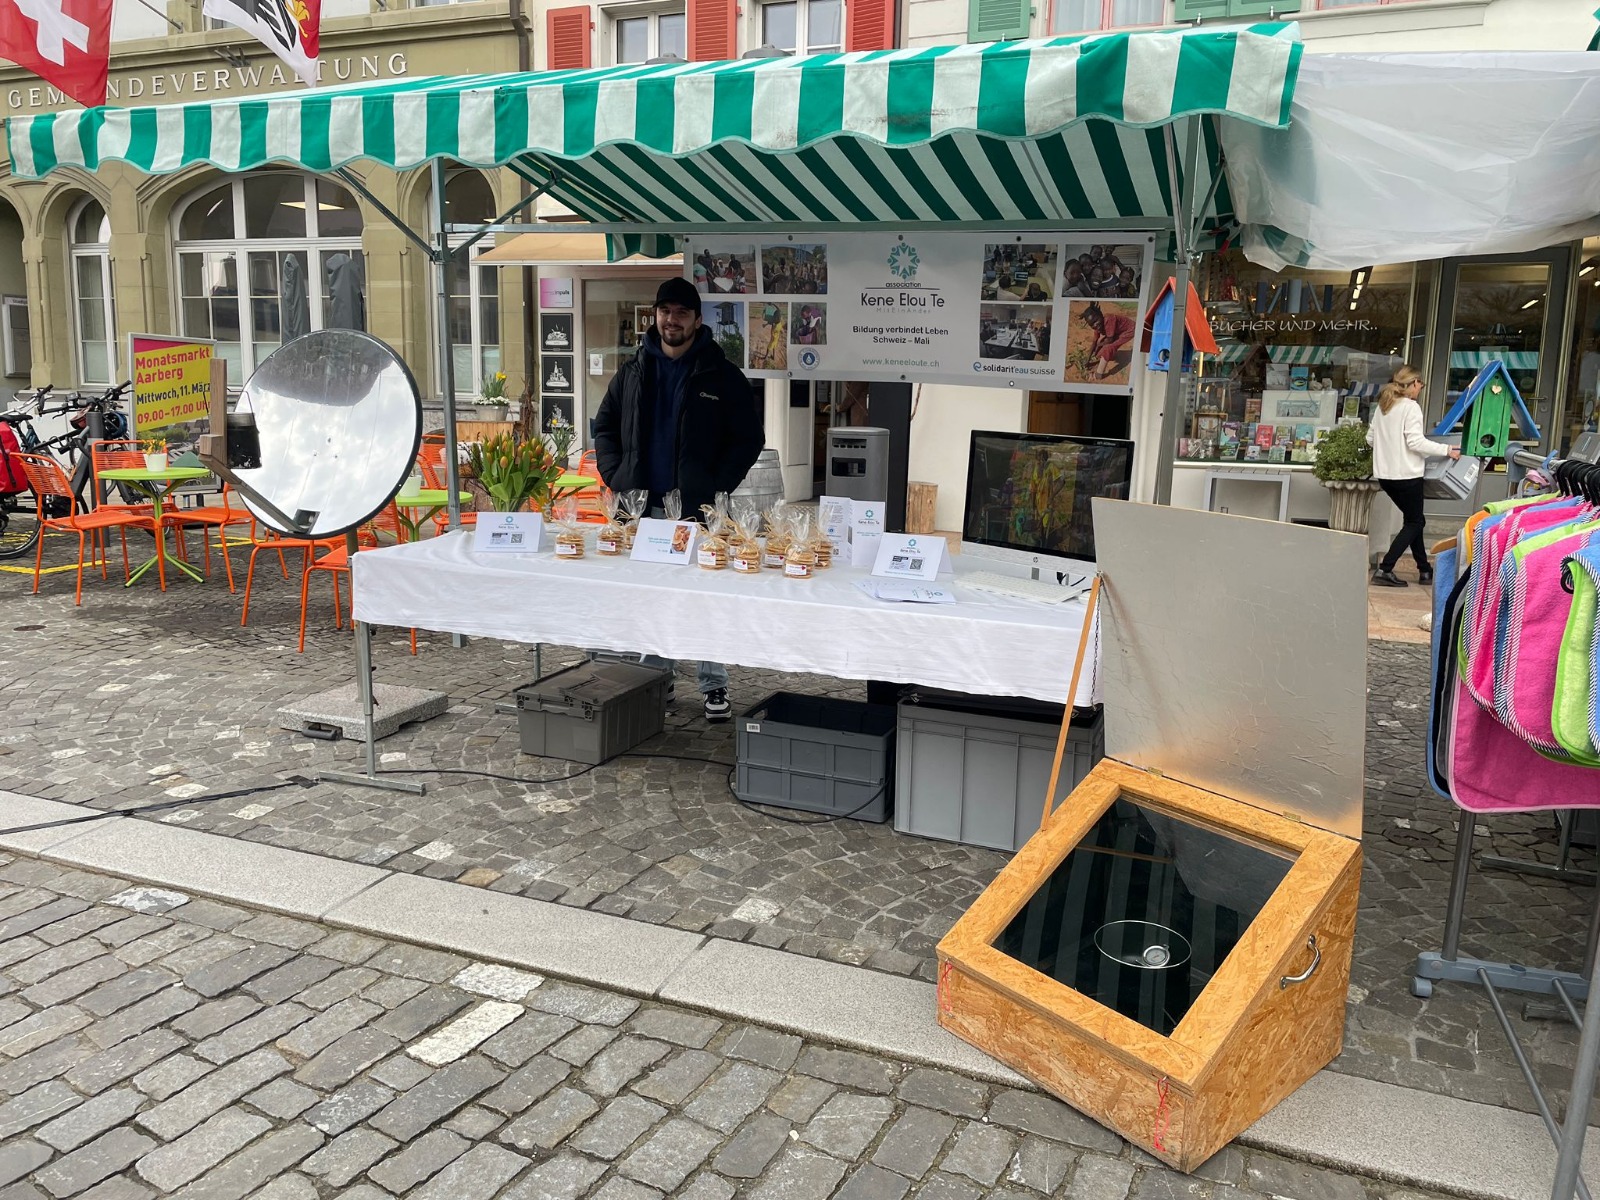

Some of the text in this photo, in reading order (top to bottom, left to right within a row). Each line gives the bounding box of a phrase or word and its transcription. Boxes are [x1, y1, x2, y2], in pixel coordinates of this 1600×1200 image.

[861, 292, 945, 308] Kene Elou Te
[852, 325, 949, 336] Bildung verbindet Leben
[1280, 319, 1316, 332] UND
[872, 335, 907, 345] Schweiz
[913, 336, 930, 345] Mali
[135, 346, 210, 371] Monatsmarkt
[862, 358, 940, 368] www.keneeloute.ch
[136, 367, 183, 385] Aarberg
[1029, 366, 1056, 376] suisse
[136, 387, 180, 405] Mittwoch,
[179, 384, 191, 397] 11.
